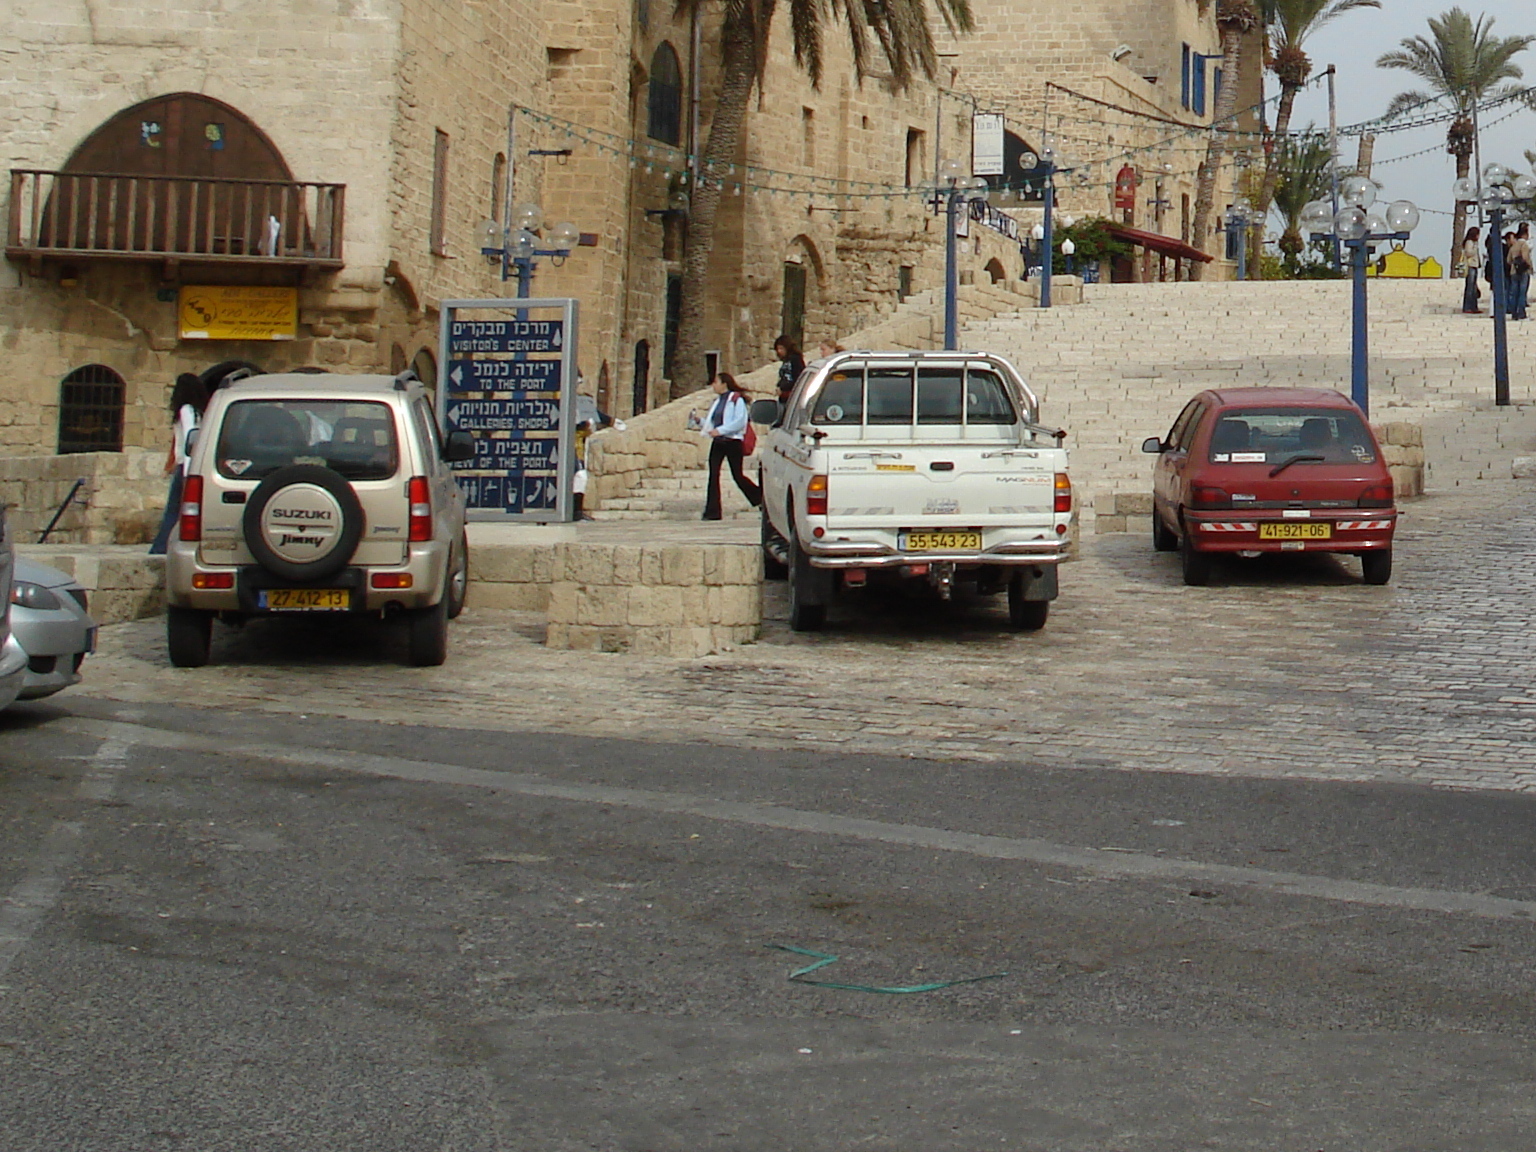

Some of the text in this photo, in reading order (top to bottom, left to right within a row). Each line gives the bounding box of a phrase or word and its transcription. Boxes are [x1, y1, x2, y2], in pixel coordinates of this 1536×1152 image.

[453, 322, 550, 337] מרכז מבקרים
[453, 337, 549, 350] VISITOR'S CENTER
[473, 361, 554, 376] ירידה לנמל
[480, 379, 546, 390] TO THE PORT
[460, 402, 500, 415] חנויות
[518, 417, 549, 428] SHOPS
[495, 441, 542, 455] תצפית
[480, 457, 493, 468] OF
[498, 457, 517, 468] THE
[523, 457, 548, 468] PORT
[272, 509, 331, 520] SUZUKI
[1265, 524, 1324, 537] 41-921-06
[279, 534, 325, 548] Jimny
